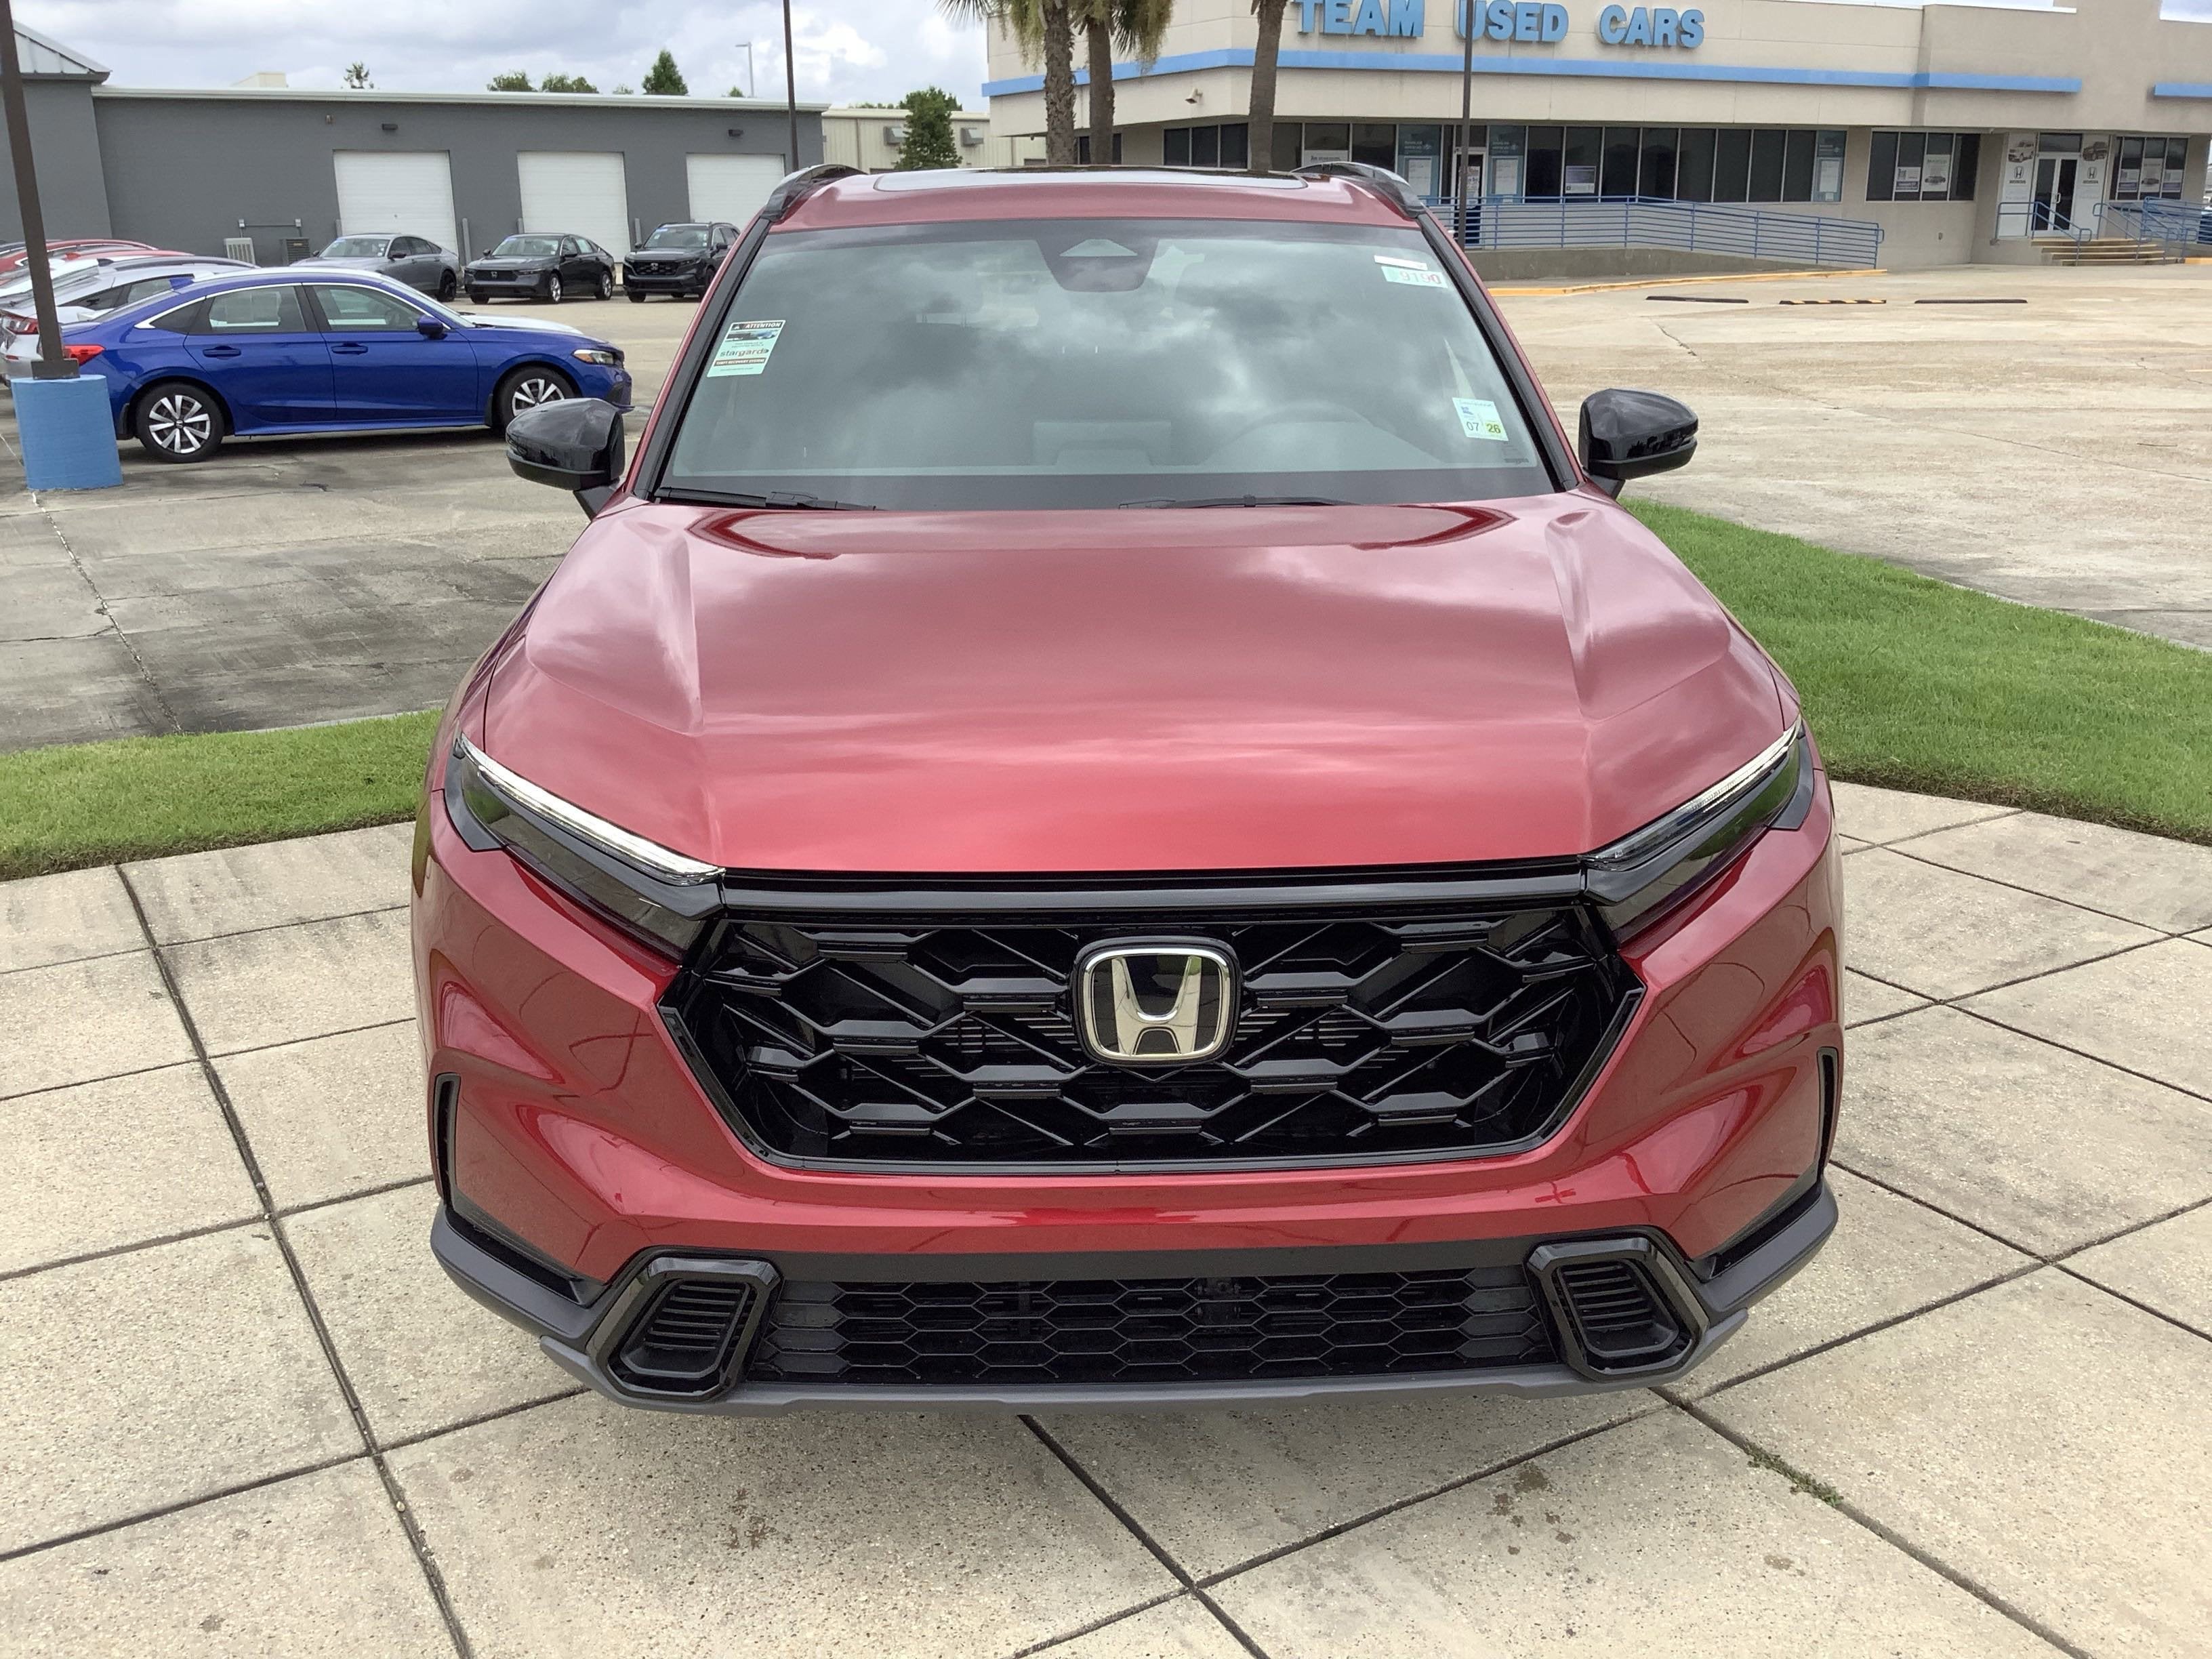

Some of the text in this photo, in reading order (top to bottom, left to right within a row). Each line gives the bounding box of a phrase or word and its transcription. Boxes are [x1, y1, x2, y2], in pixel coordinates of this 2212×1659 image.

[1296, 0, 1705, 48] TEAM USED CARS
[1399, 271, 1440, 284] 9190
[1466, 421, 1502, 434] 07 26
